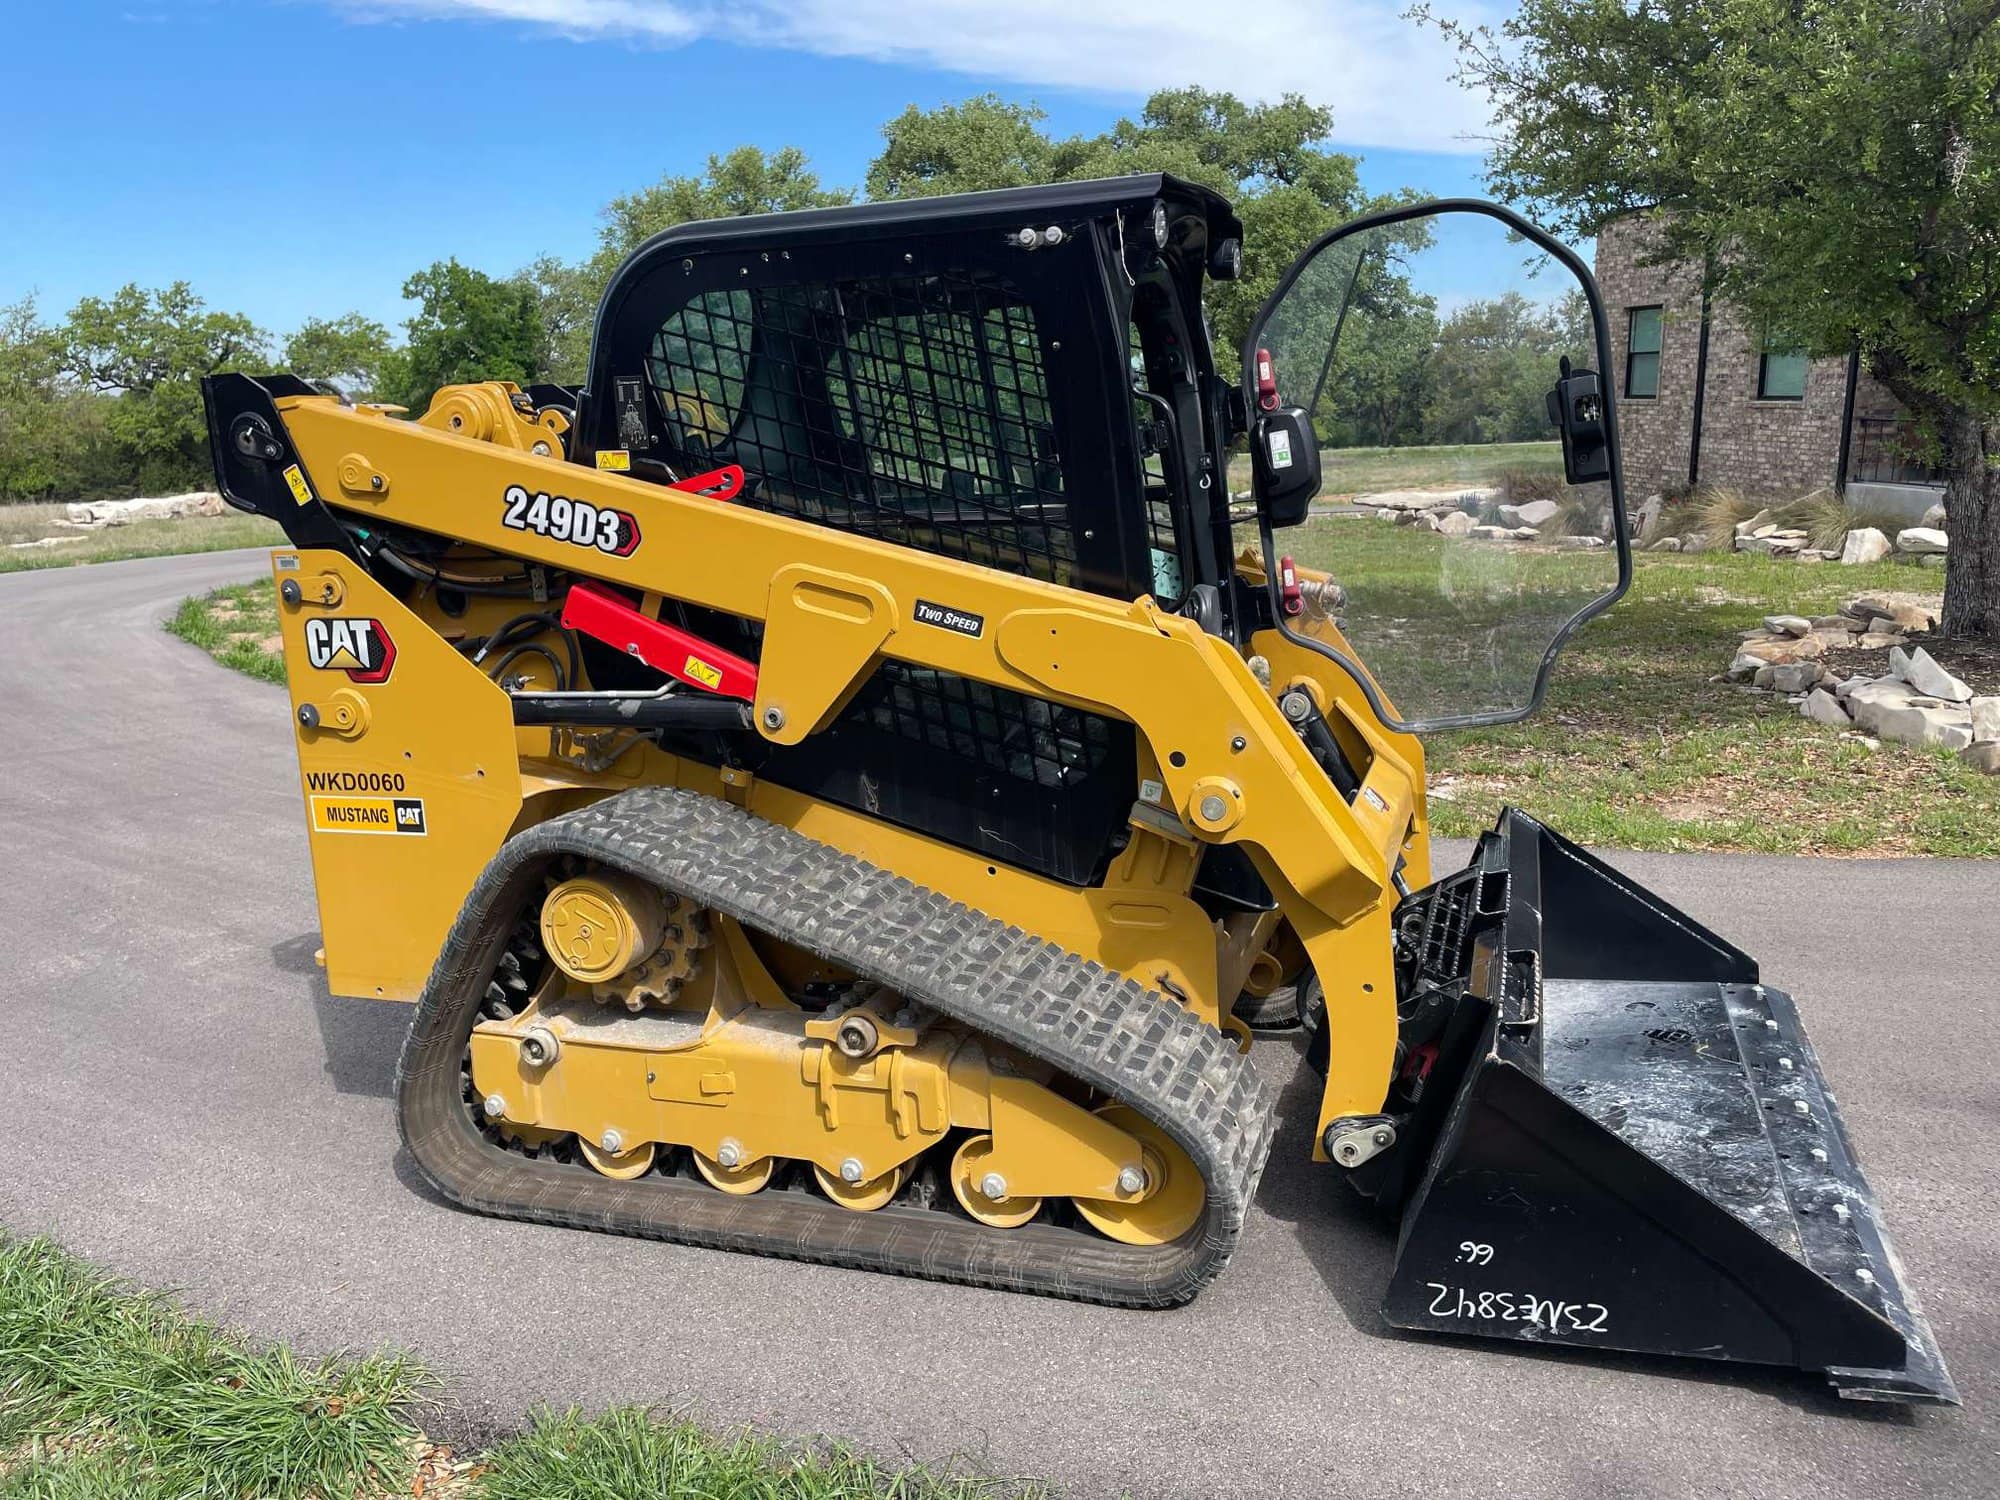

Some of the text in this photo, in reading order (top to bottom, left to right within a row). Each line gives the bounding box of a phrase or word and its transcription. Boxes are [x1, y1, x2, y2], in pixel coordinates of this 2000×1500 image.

[503, 486, 620, 552] 249D3
[306, 619, 371, 668] CAT
[306, 772, 405, 792] WKD0060
[326, 806, 421, 825] MUSTANG CAT
